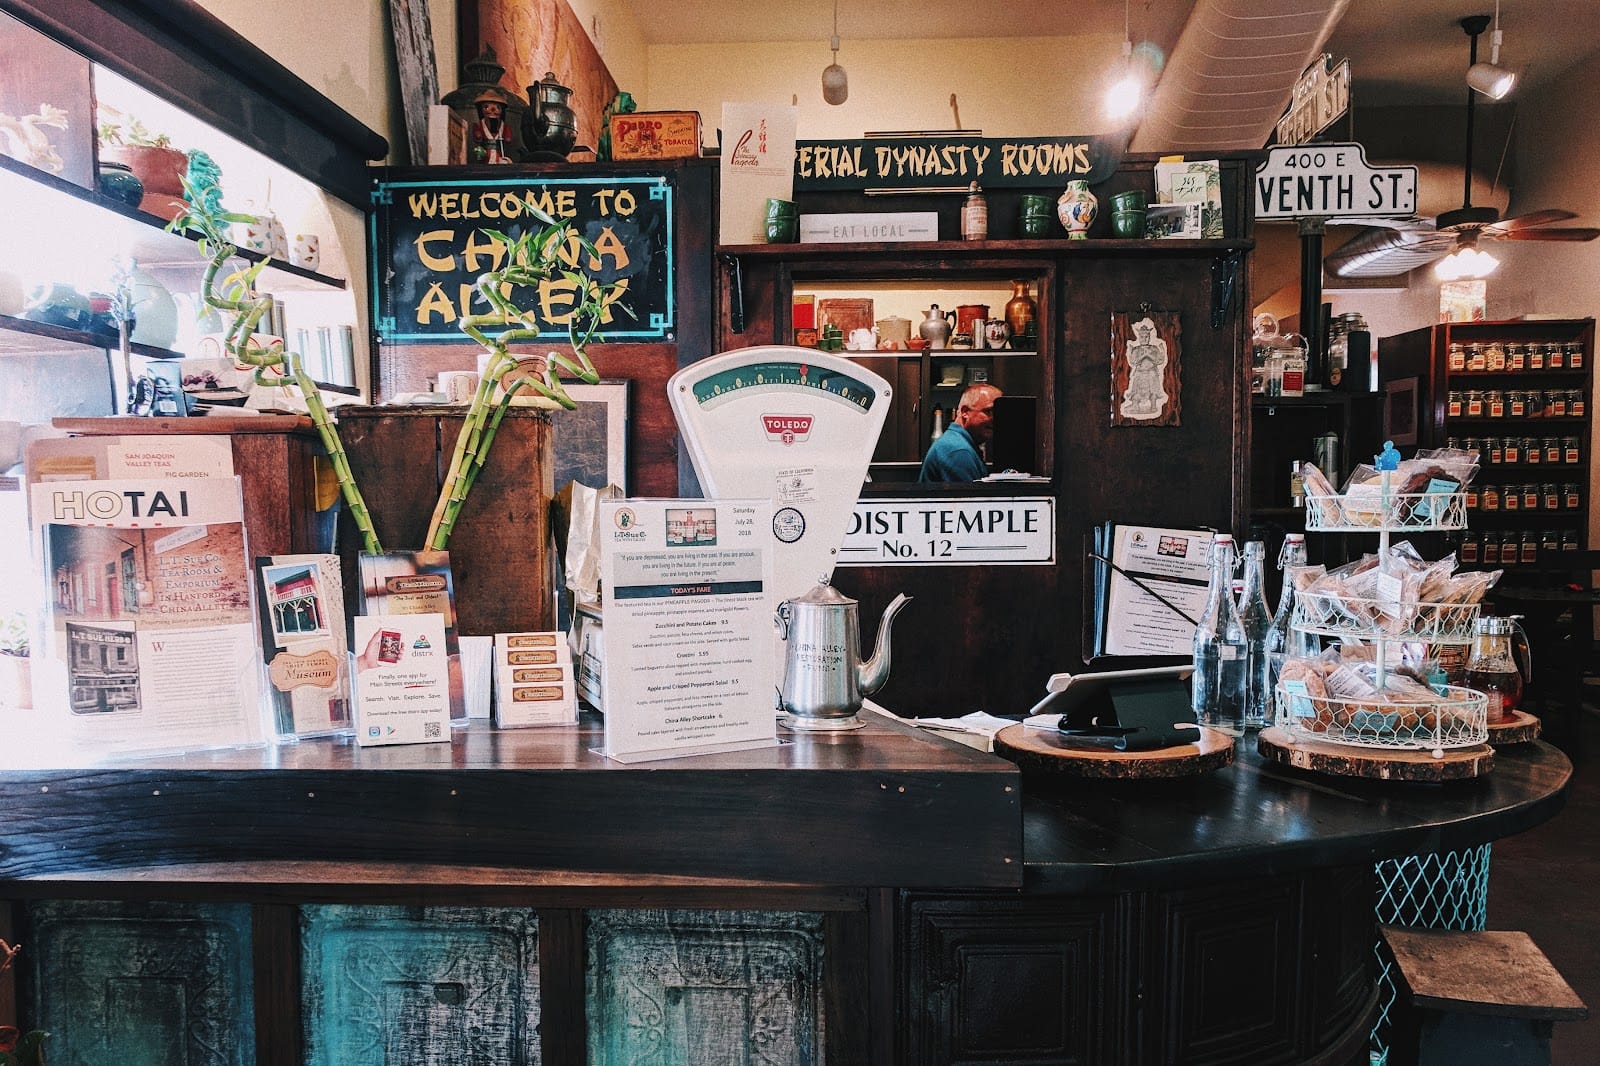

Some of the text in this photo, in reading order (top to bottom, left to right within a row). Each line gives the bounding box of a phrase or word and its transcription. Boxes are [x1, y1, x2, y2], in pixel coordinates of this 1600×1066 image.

[797, 143, 1092, 178] ERIAL DYNASTY ROOMS
[1284, 153, 1344, 168] 400 E
[1258, 174, 1409, 212] VENTH ST.
[408, 188, 637, 220] WELCOME TO
[834, 225, 904, 238] EAT LOCAL
[413, 226, 630, 272] CHINA
[416, 278, 630, 326] ALLEY
[767, 420, 809, 428] TOLEDO
[53, 490, 188, 519] HOTAI
[918, 510, 1038, 534] TEMPLE
[883, 540, 952, 558] No. 12
[214, 566, 222, 574] &
[166, 580, 220, 589] EMPORIUM
[412, 649, 433, 657] distrx
[284, 668, 331, 680] Museum
[679, 715, 690, 723] Alley
[691, 713, 715, 721] Shortcake
